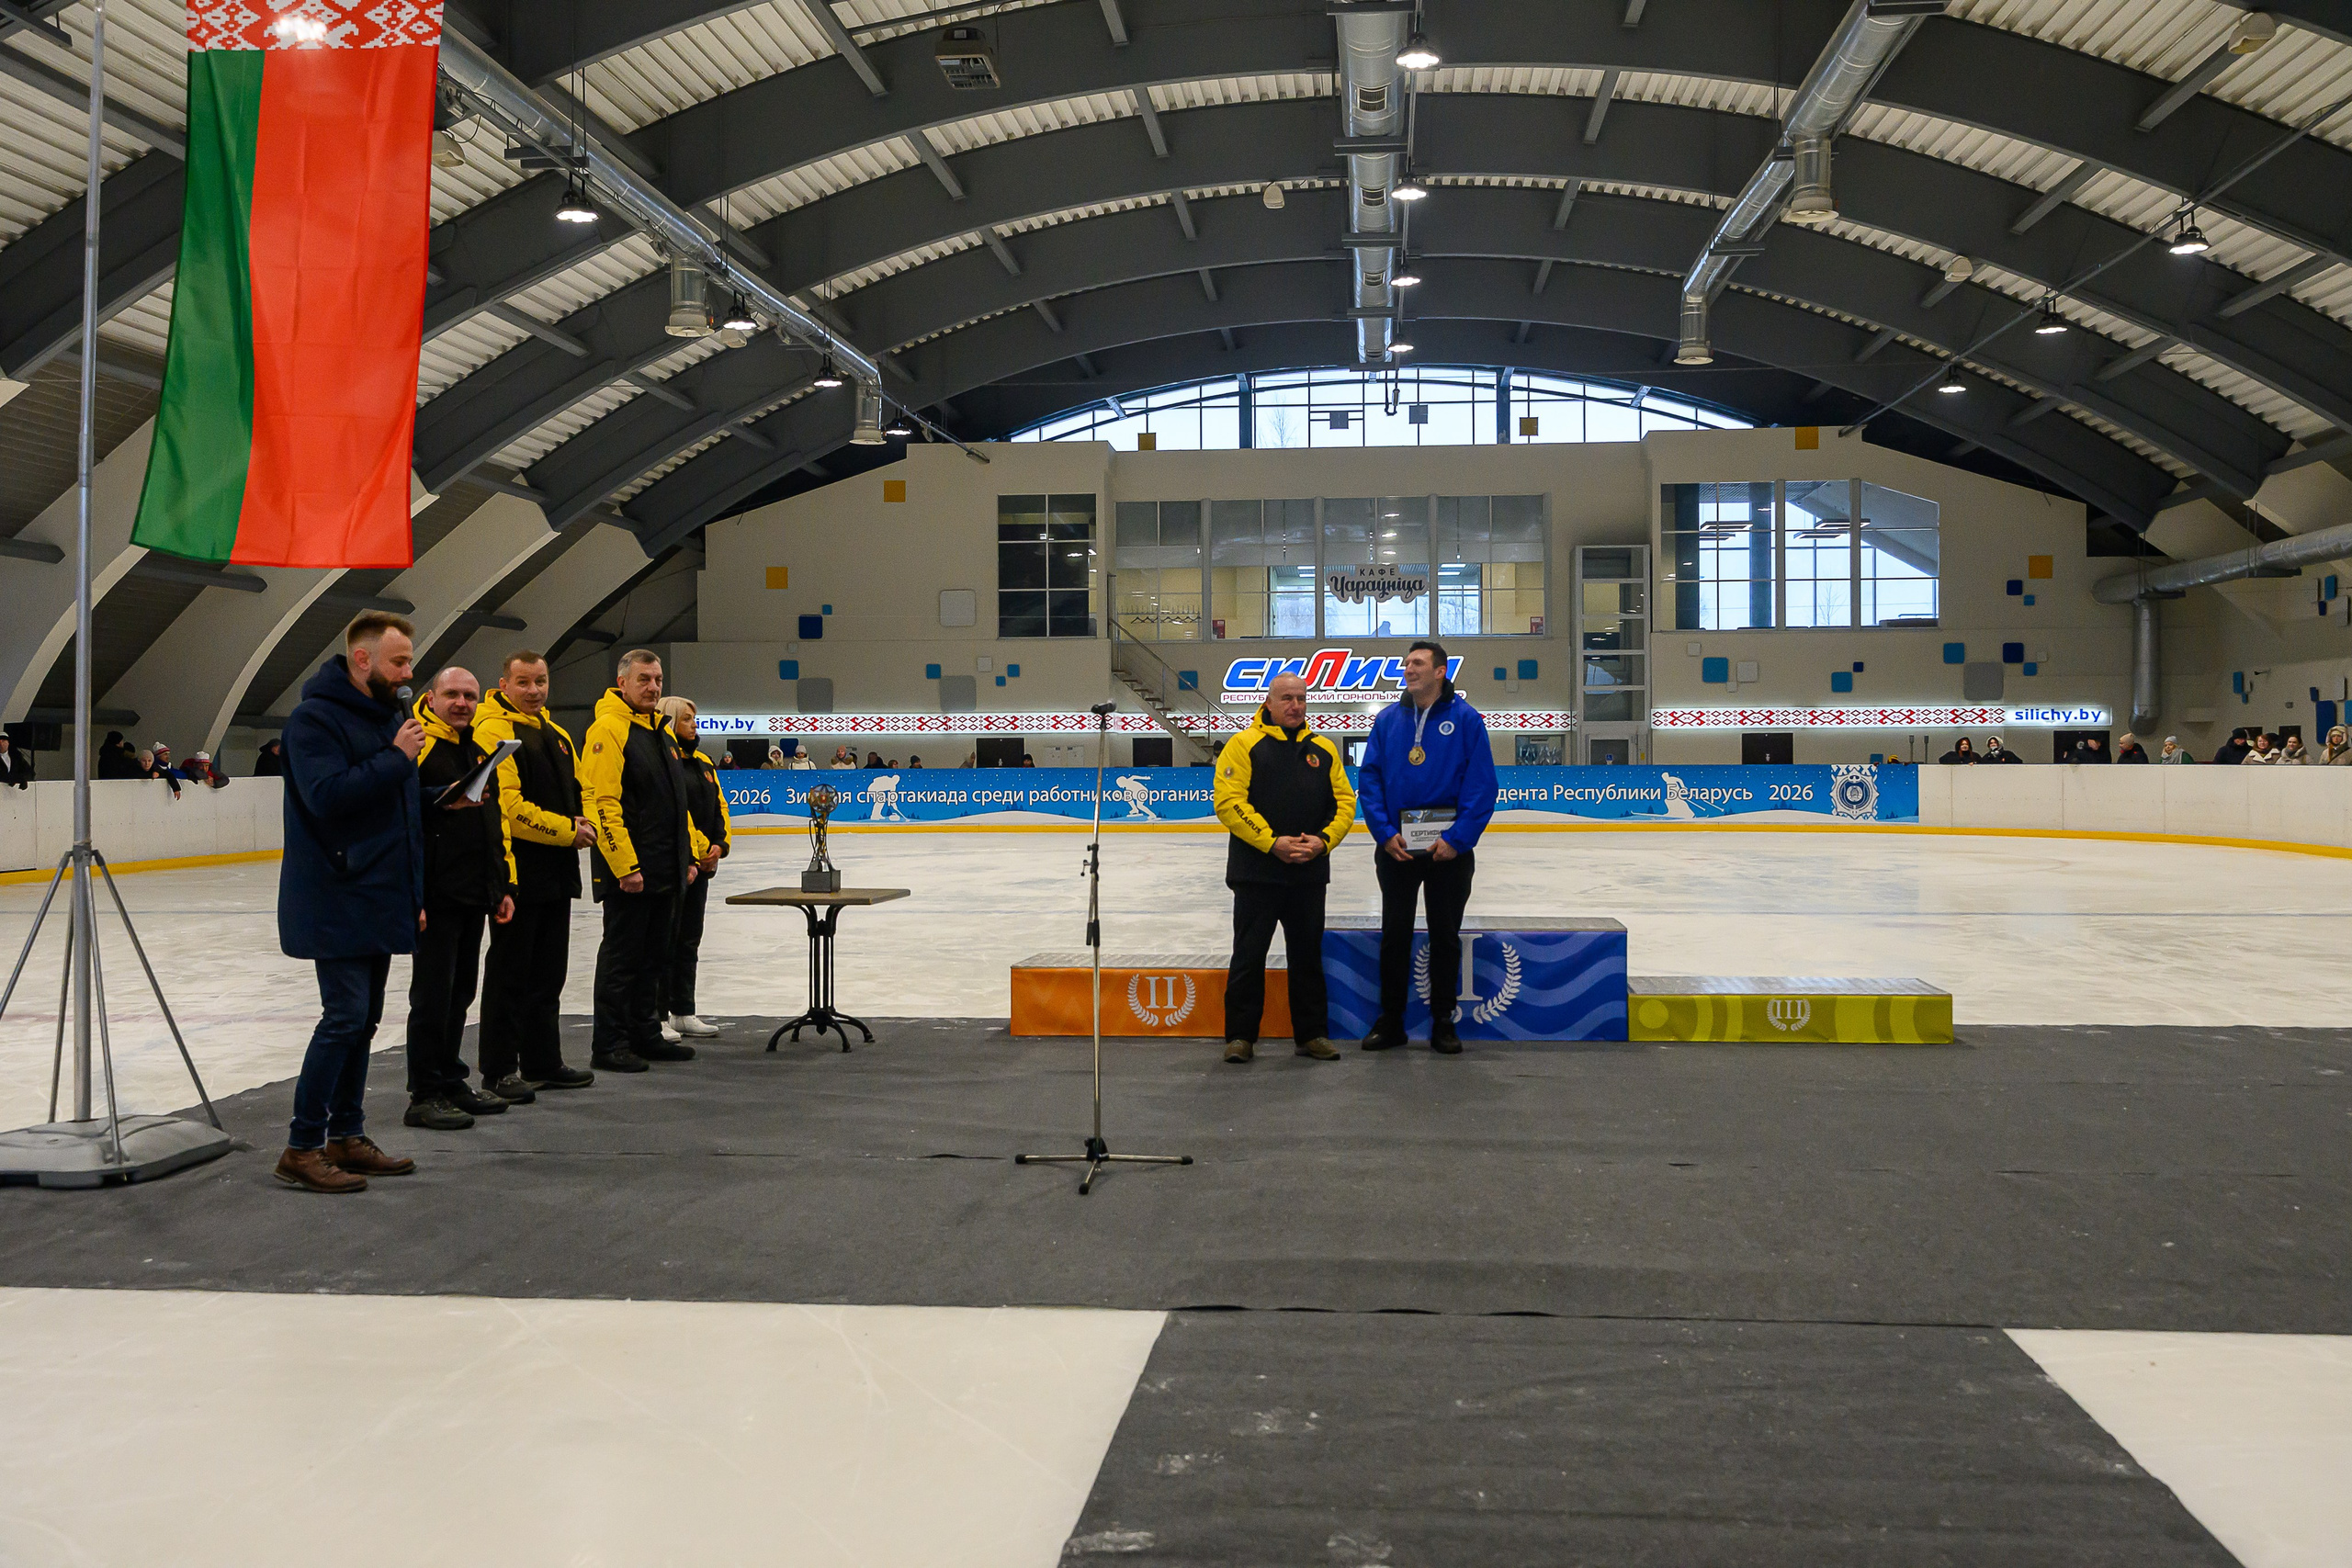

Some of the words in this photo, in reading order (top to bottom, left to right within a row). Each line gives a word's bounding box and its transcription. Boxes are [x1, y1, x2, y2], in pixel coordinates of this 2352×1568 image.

[1330, 575, 1424, 599] Чараўніца
[1223, 693, 1335, 702] РЕСПУБСКИЙ
[695, 718, 754, 731] ichy.by
[2015, 708, 2102, 723] silichy.by
[729, 789, 771, 805] 2026
[856, 790, 967, 807] спартакиада
[972, 790, 1024, 806] среди
[1029, 785, 1133, 806] работников
[1137, 789, 1215, 806] организа
[1553, 784, 1661, 804] Республики
[1666, 783, 1753, 804] Беларусь
[1769, 784, 1814, 800] 2026
[515, 814, 558, 837] BELARUS
[597, 808, 617, 852] BELARUS
[1233, 804, 1262, 834] BELARUS
[1456, 933, 1483, 1001] I
[1145, 976, 1178, 1009] II
[1774, 999, 1804, 1019] III
